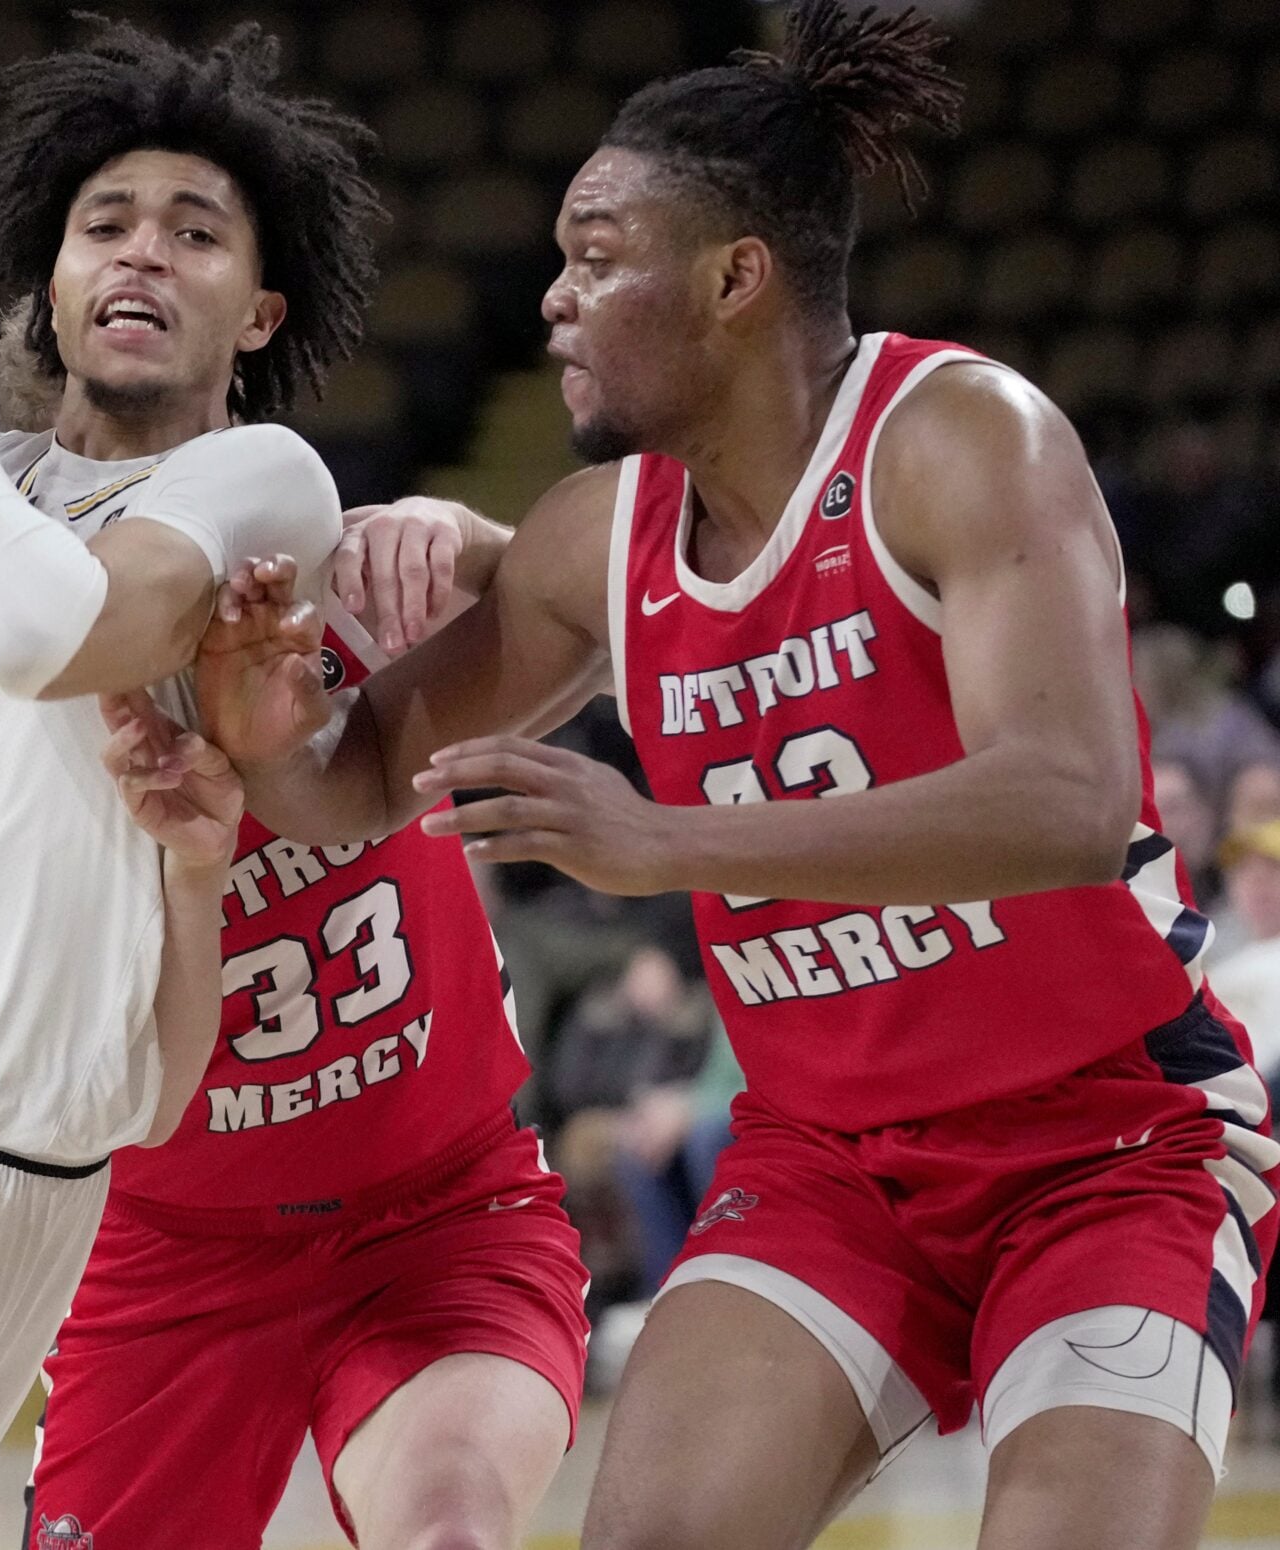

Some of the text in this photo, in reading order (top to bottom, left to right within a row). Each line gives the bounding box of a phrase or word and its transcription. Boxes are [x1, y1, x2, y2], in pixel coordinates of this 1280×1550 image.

[826, 482, 847, 508] EC
[658, 608, 878, 736] DETROIT
[220, 875, 415, 1065] 33
[710, 899, 1008, 1007] MERCY
[206, 1007, 434, 1133] MERCY
[276, 1198, 344, 1217] TITANS
